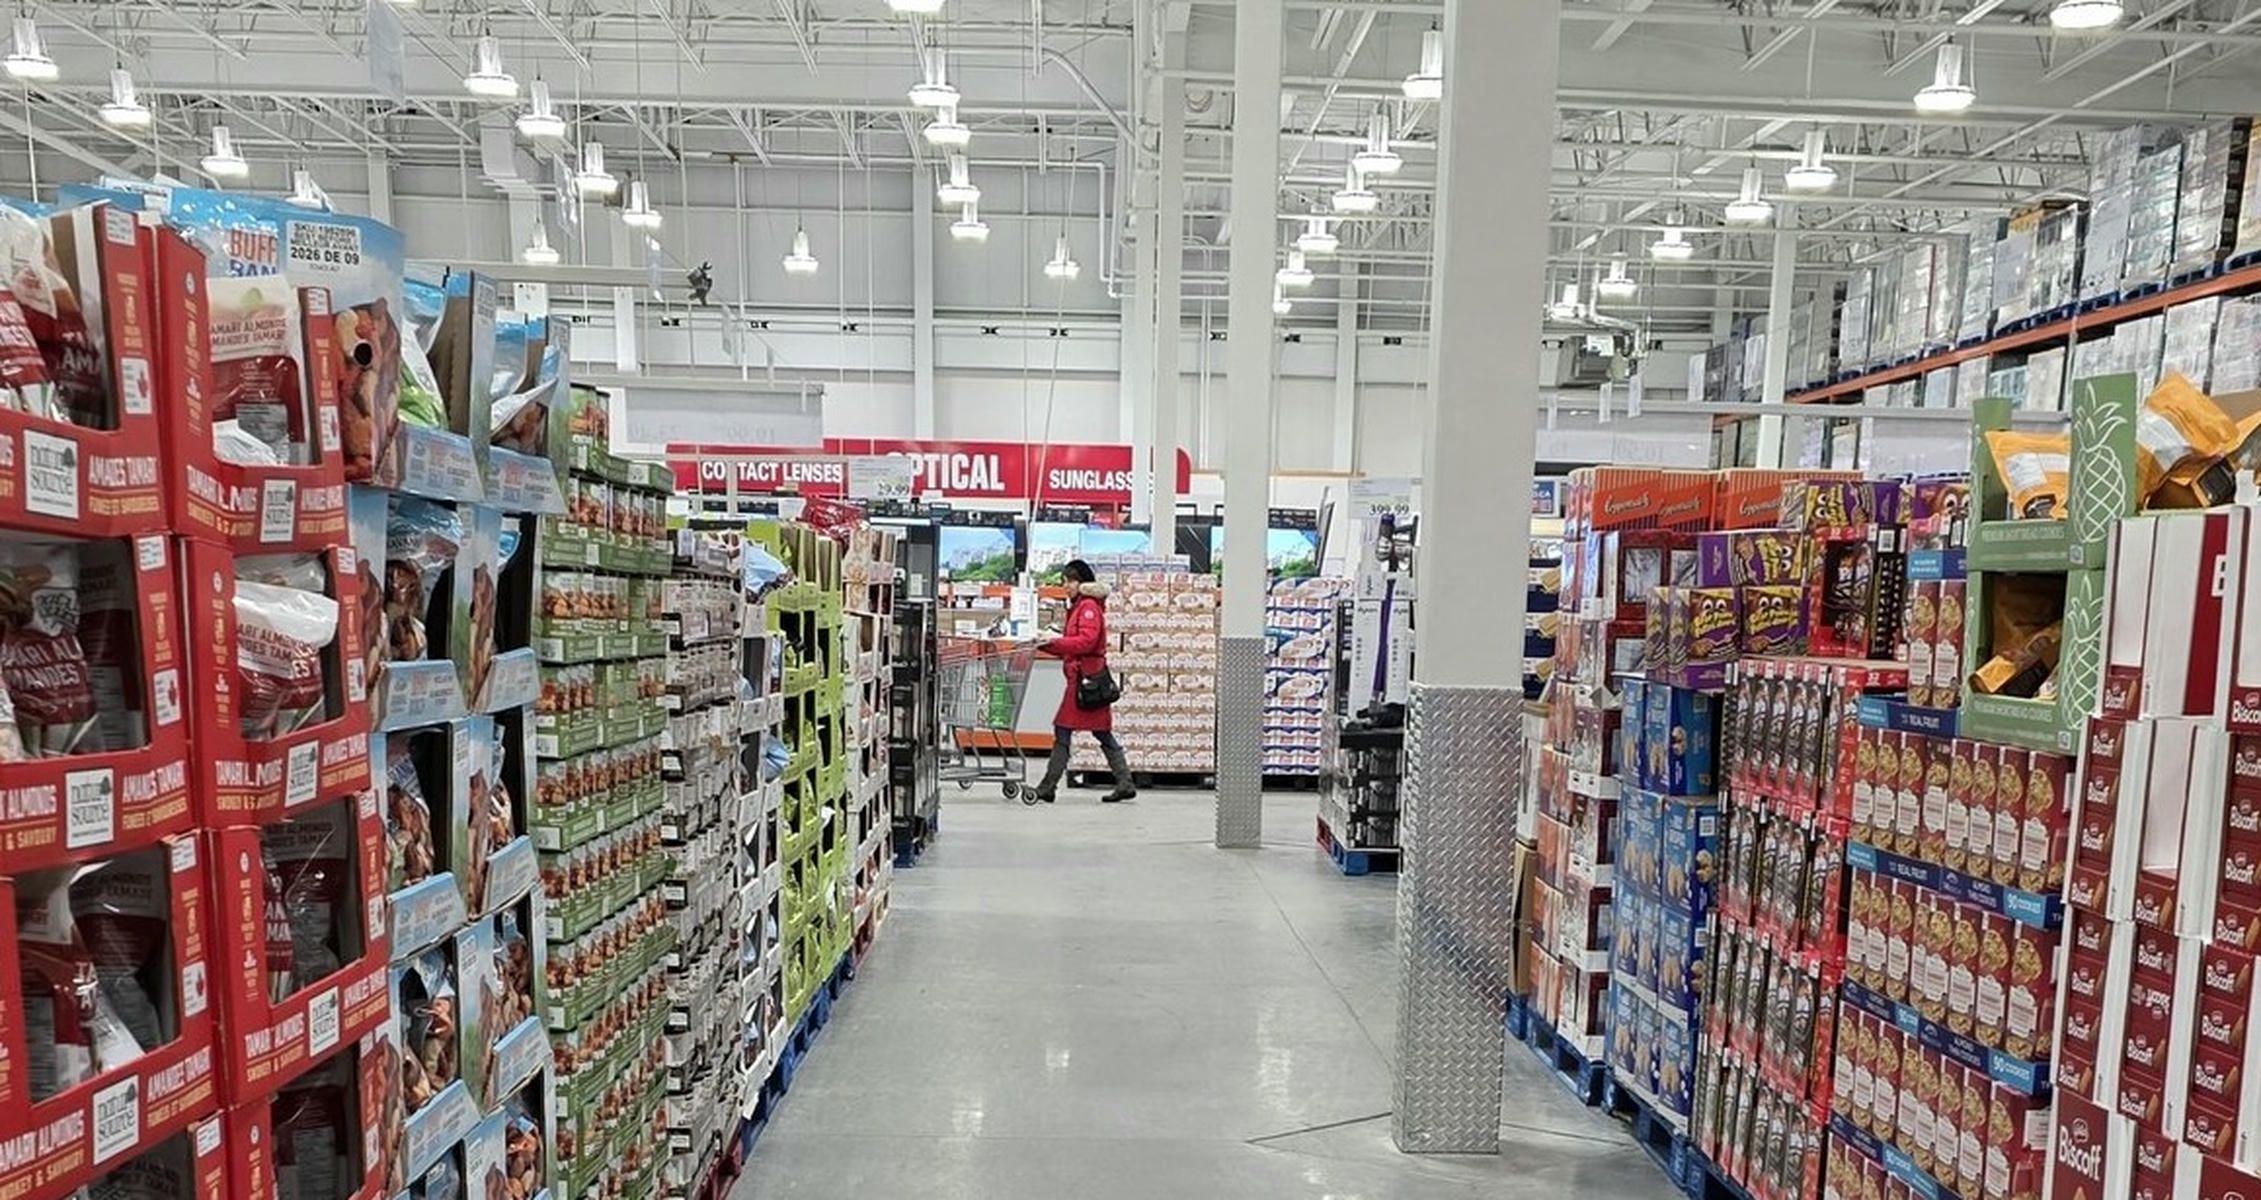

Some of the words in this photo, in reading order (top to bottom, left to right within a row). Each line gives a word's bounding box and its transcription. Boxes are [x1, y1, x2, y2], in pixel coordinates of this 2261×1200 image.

[290, 247, 320, 261] 2026
[324, 250, 341, 263] DE
[344, 252, 360, 265] 09
[702, 461, 779, 481] COTACT
[783, 462, 843, 483] LENSES
[2058, 1124, 2102, 1181] Biscoff
